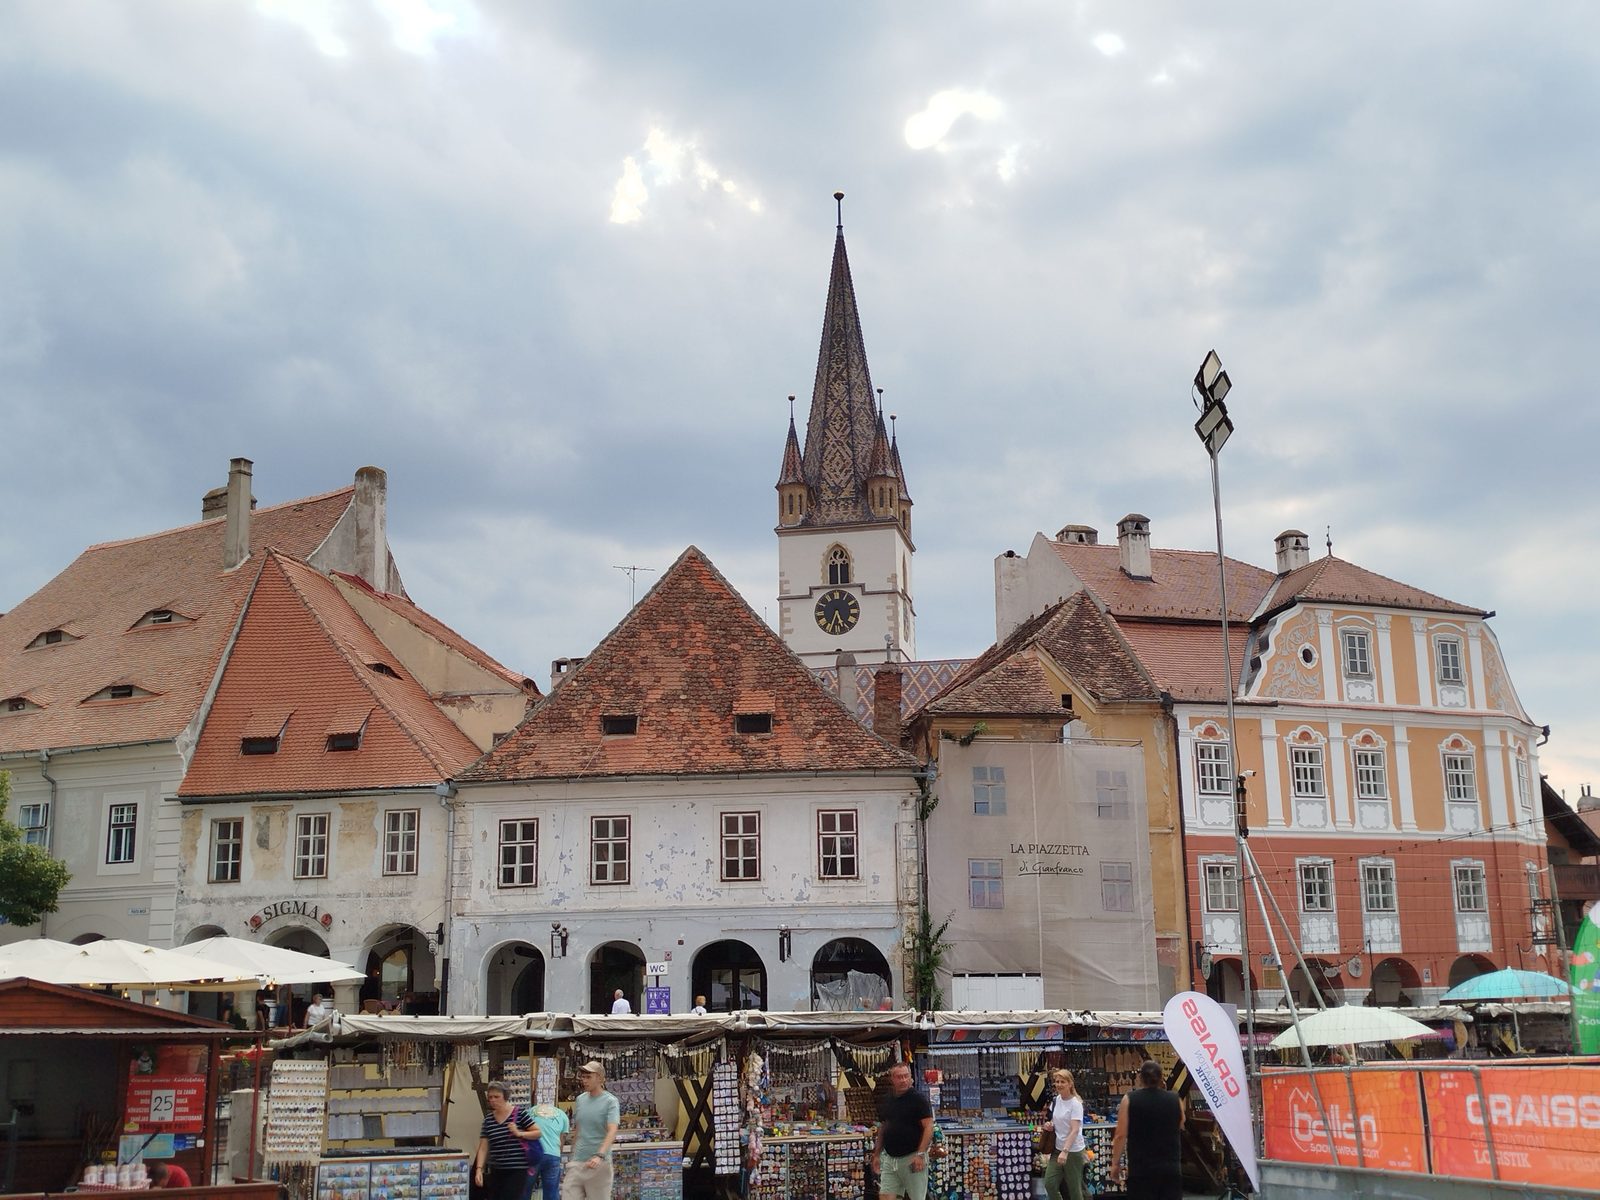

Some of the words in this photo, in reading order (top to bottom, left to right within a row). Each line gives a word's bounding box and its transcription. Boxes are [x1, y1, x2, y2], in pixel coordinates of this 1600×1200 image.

[1010, 844, 1025, 854] LA
[1028, 844, 1090, 855] PIAZZETTA
[1019, 860, 1028, 872] di
[1032, 861, 1084, 877] Gianfranco
[263, 901, 318, 920] SIGMA
[650, 965, 665, 973] WC
[153, 1095, 173, 1112] 25
[1466, 1093, 1600, 1129] CRAISS
